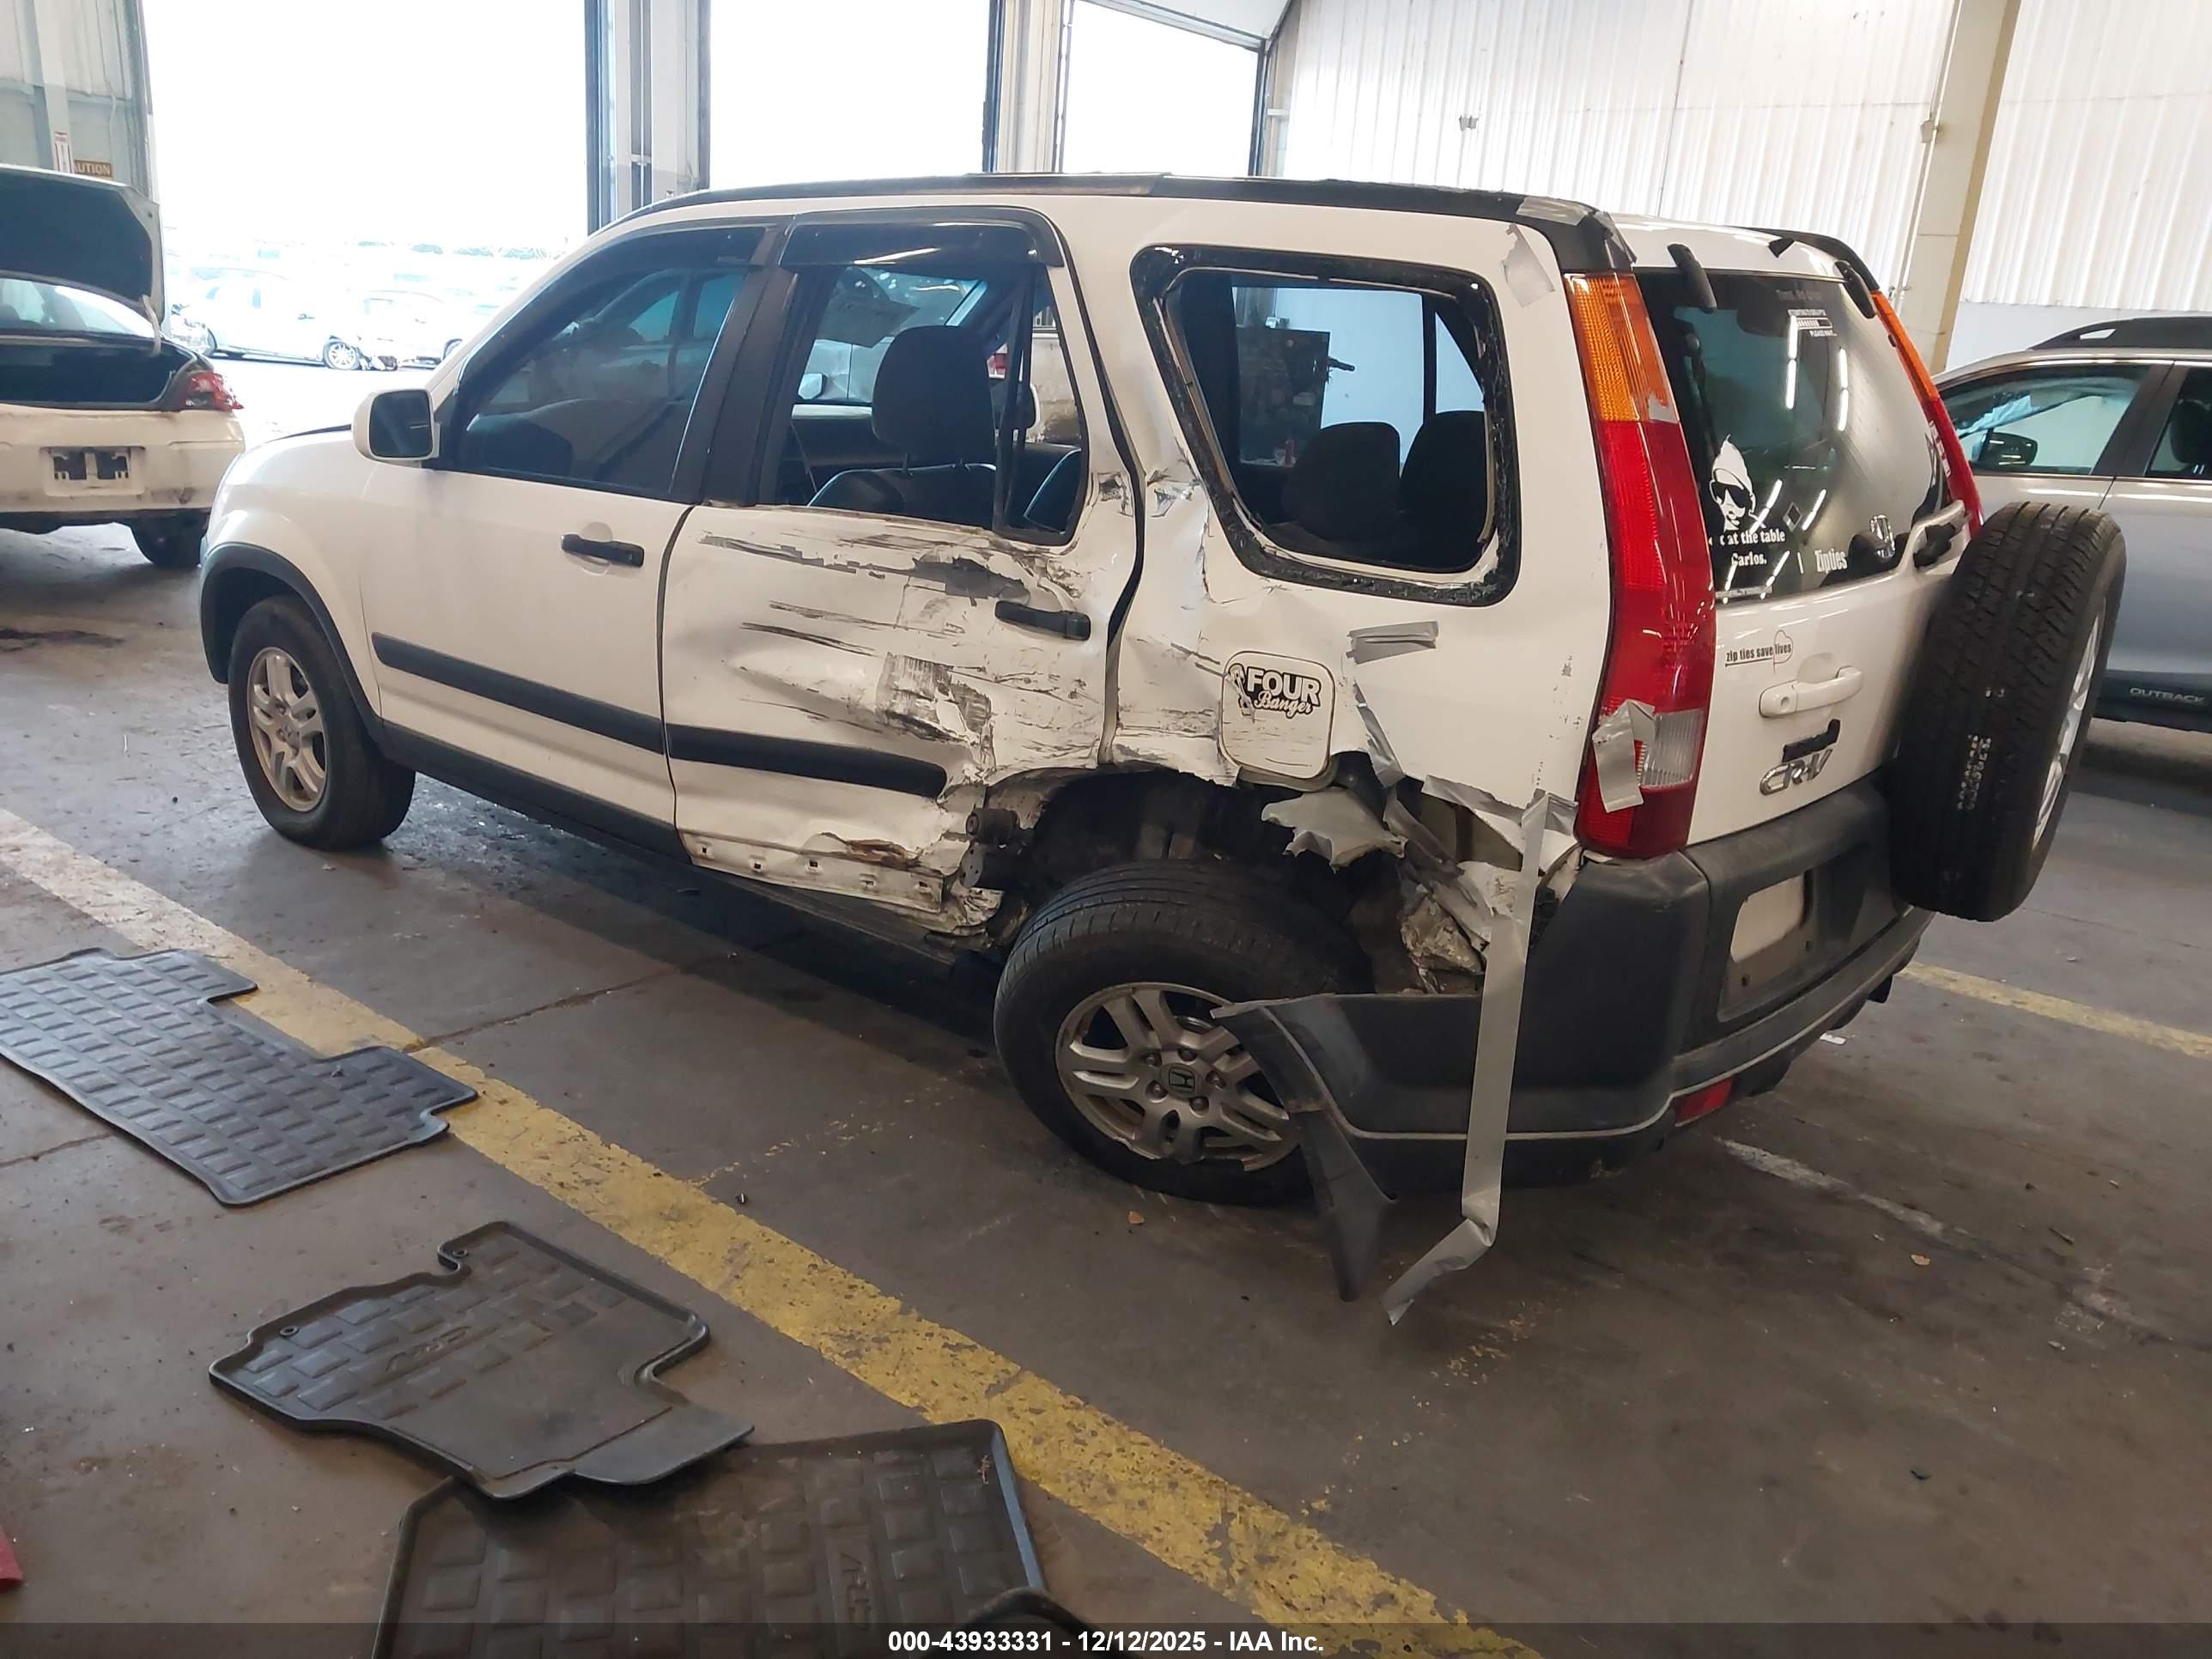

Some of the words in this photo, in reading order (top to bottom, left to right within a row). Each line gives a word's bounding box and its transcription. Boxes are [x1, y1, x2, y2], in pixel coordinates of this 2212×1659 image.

[1727, 532, 1739, 545] at
[1740, 530, 1759, 544] the
[1759, 528, 1786, 543] table
[1731, 551, 1767, 567] Carlos.
[1814, 548, 1848, 574] Zipties
[1726, 650, 1738, 662] zip
[1740, 647, 1754, 660] ties
[1756, 646, 1774, 658] save
[1775, 643, 1792, 655] lives
[1247, 667, 1322, 706] FOUR
[2130, 688, 2205, 702] OUTBACK
[1254, 690, 1312, 719] Banger
